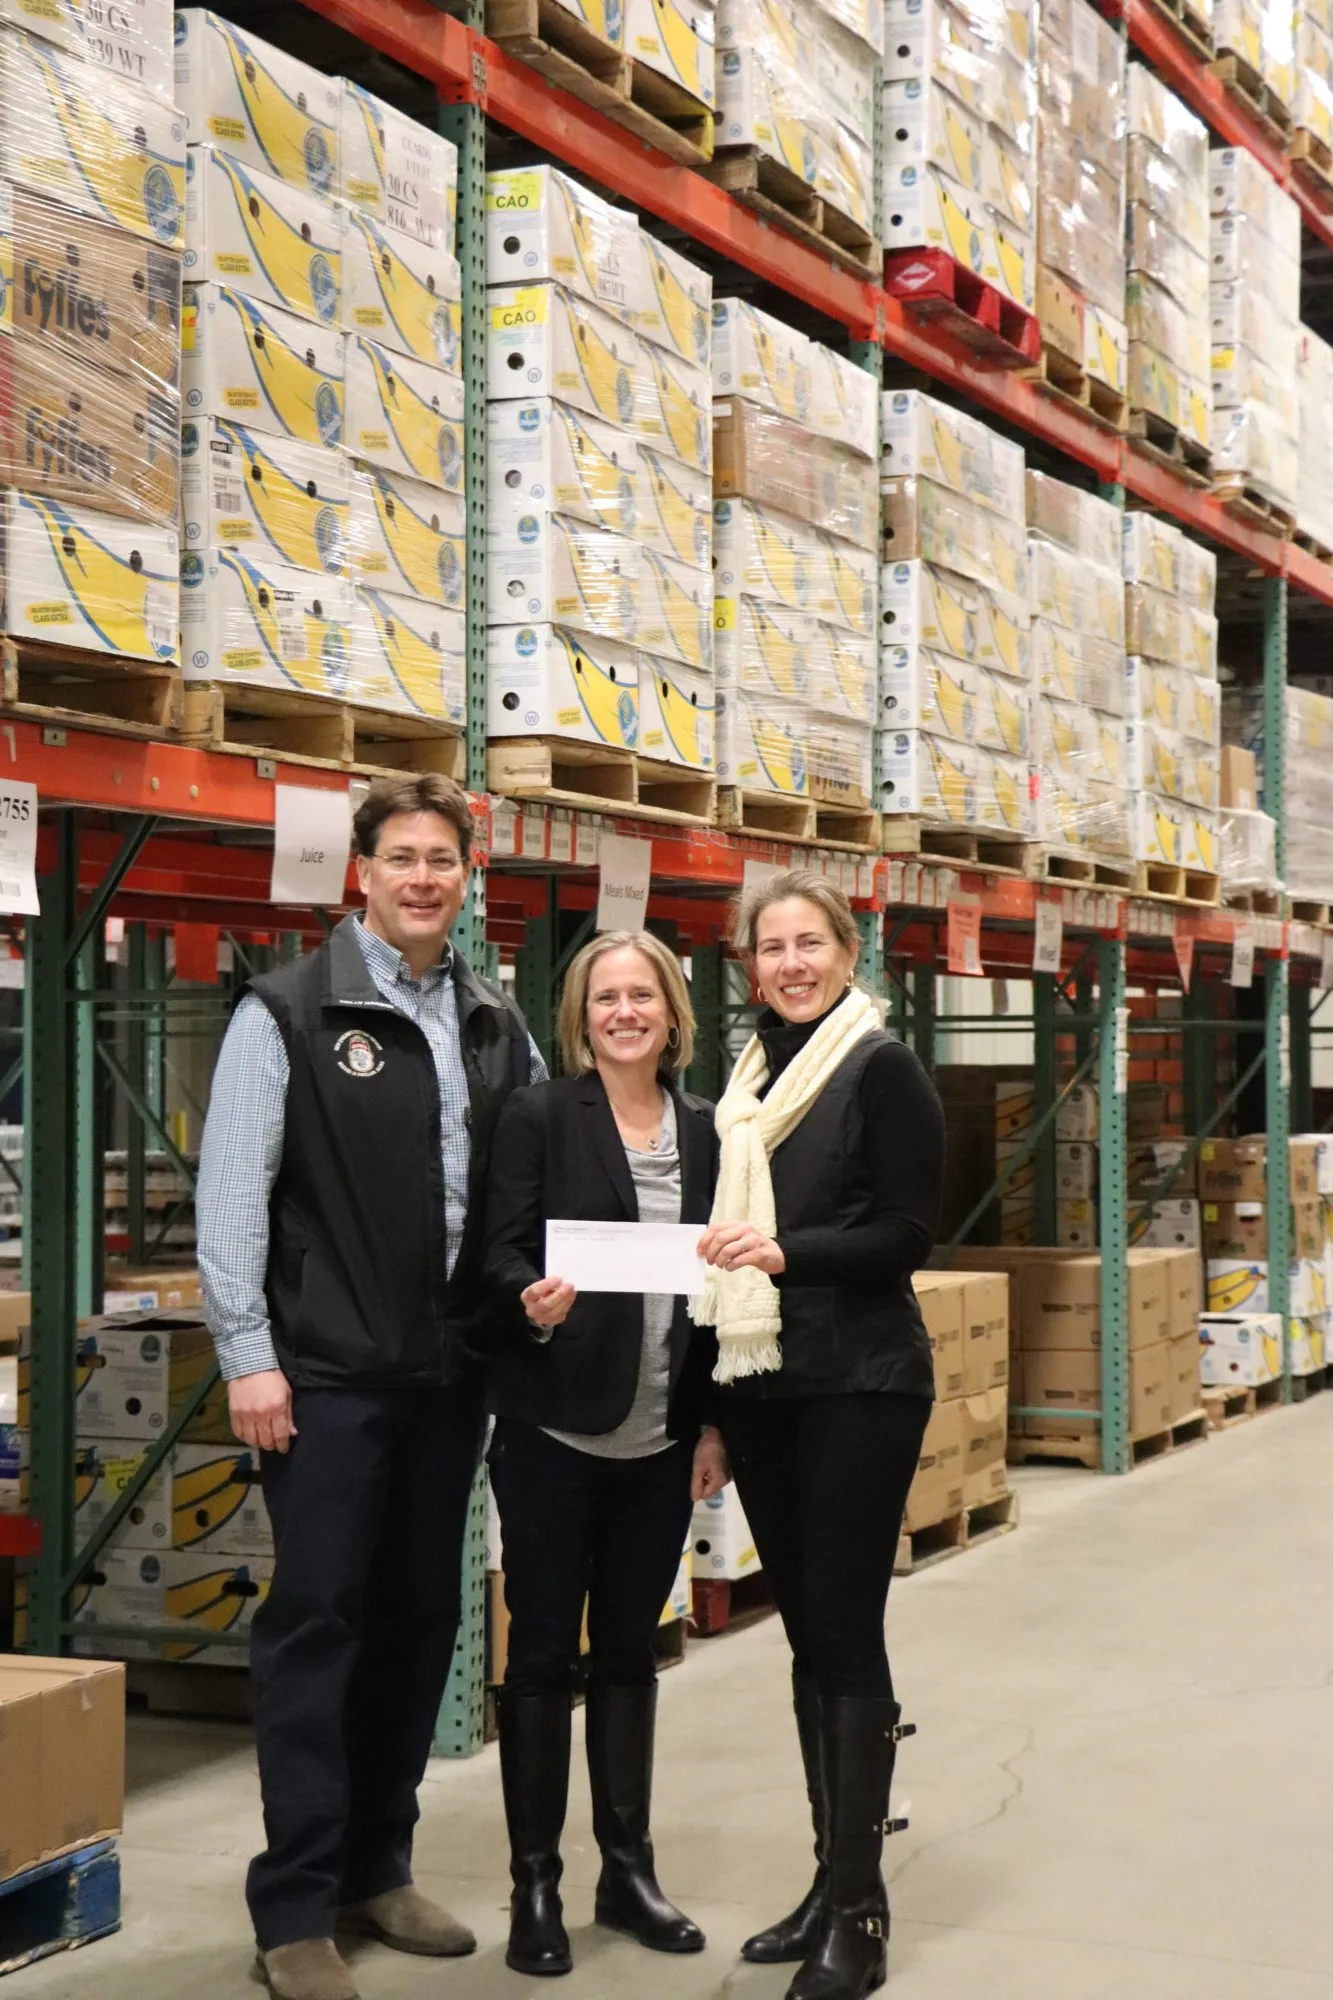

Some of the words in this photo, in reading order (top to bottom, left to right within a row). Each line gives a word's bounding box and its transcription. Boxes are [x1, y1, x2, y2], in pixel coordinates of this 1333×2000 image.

[119, 47, 146, 77] WT
[496, 195, 529, 208] CAO
[503, 310, 536, 326] CAO
[299, 847, 325, 864] Juice
